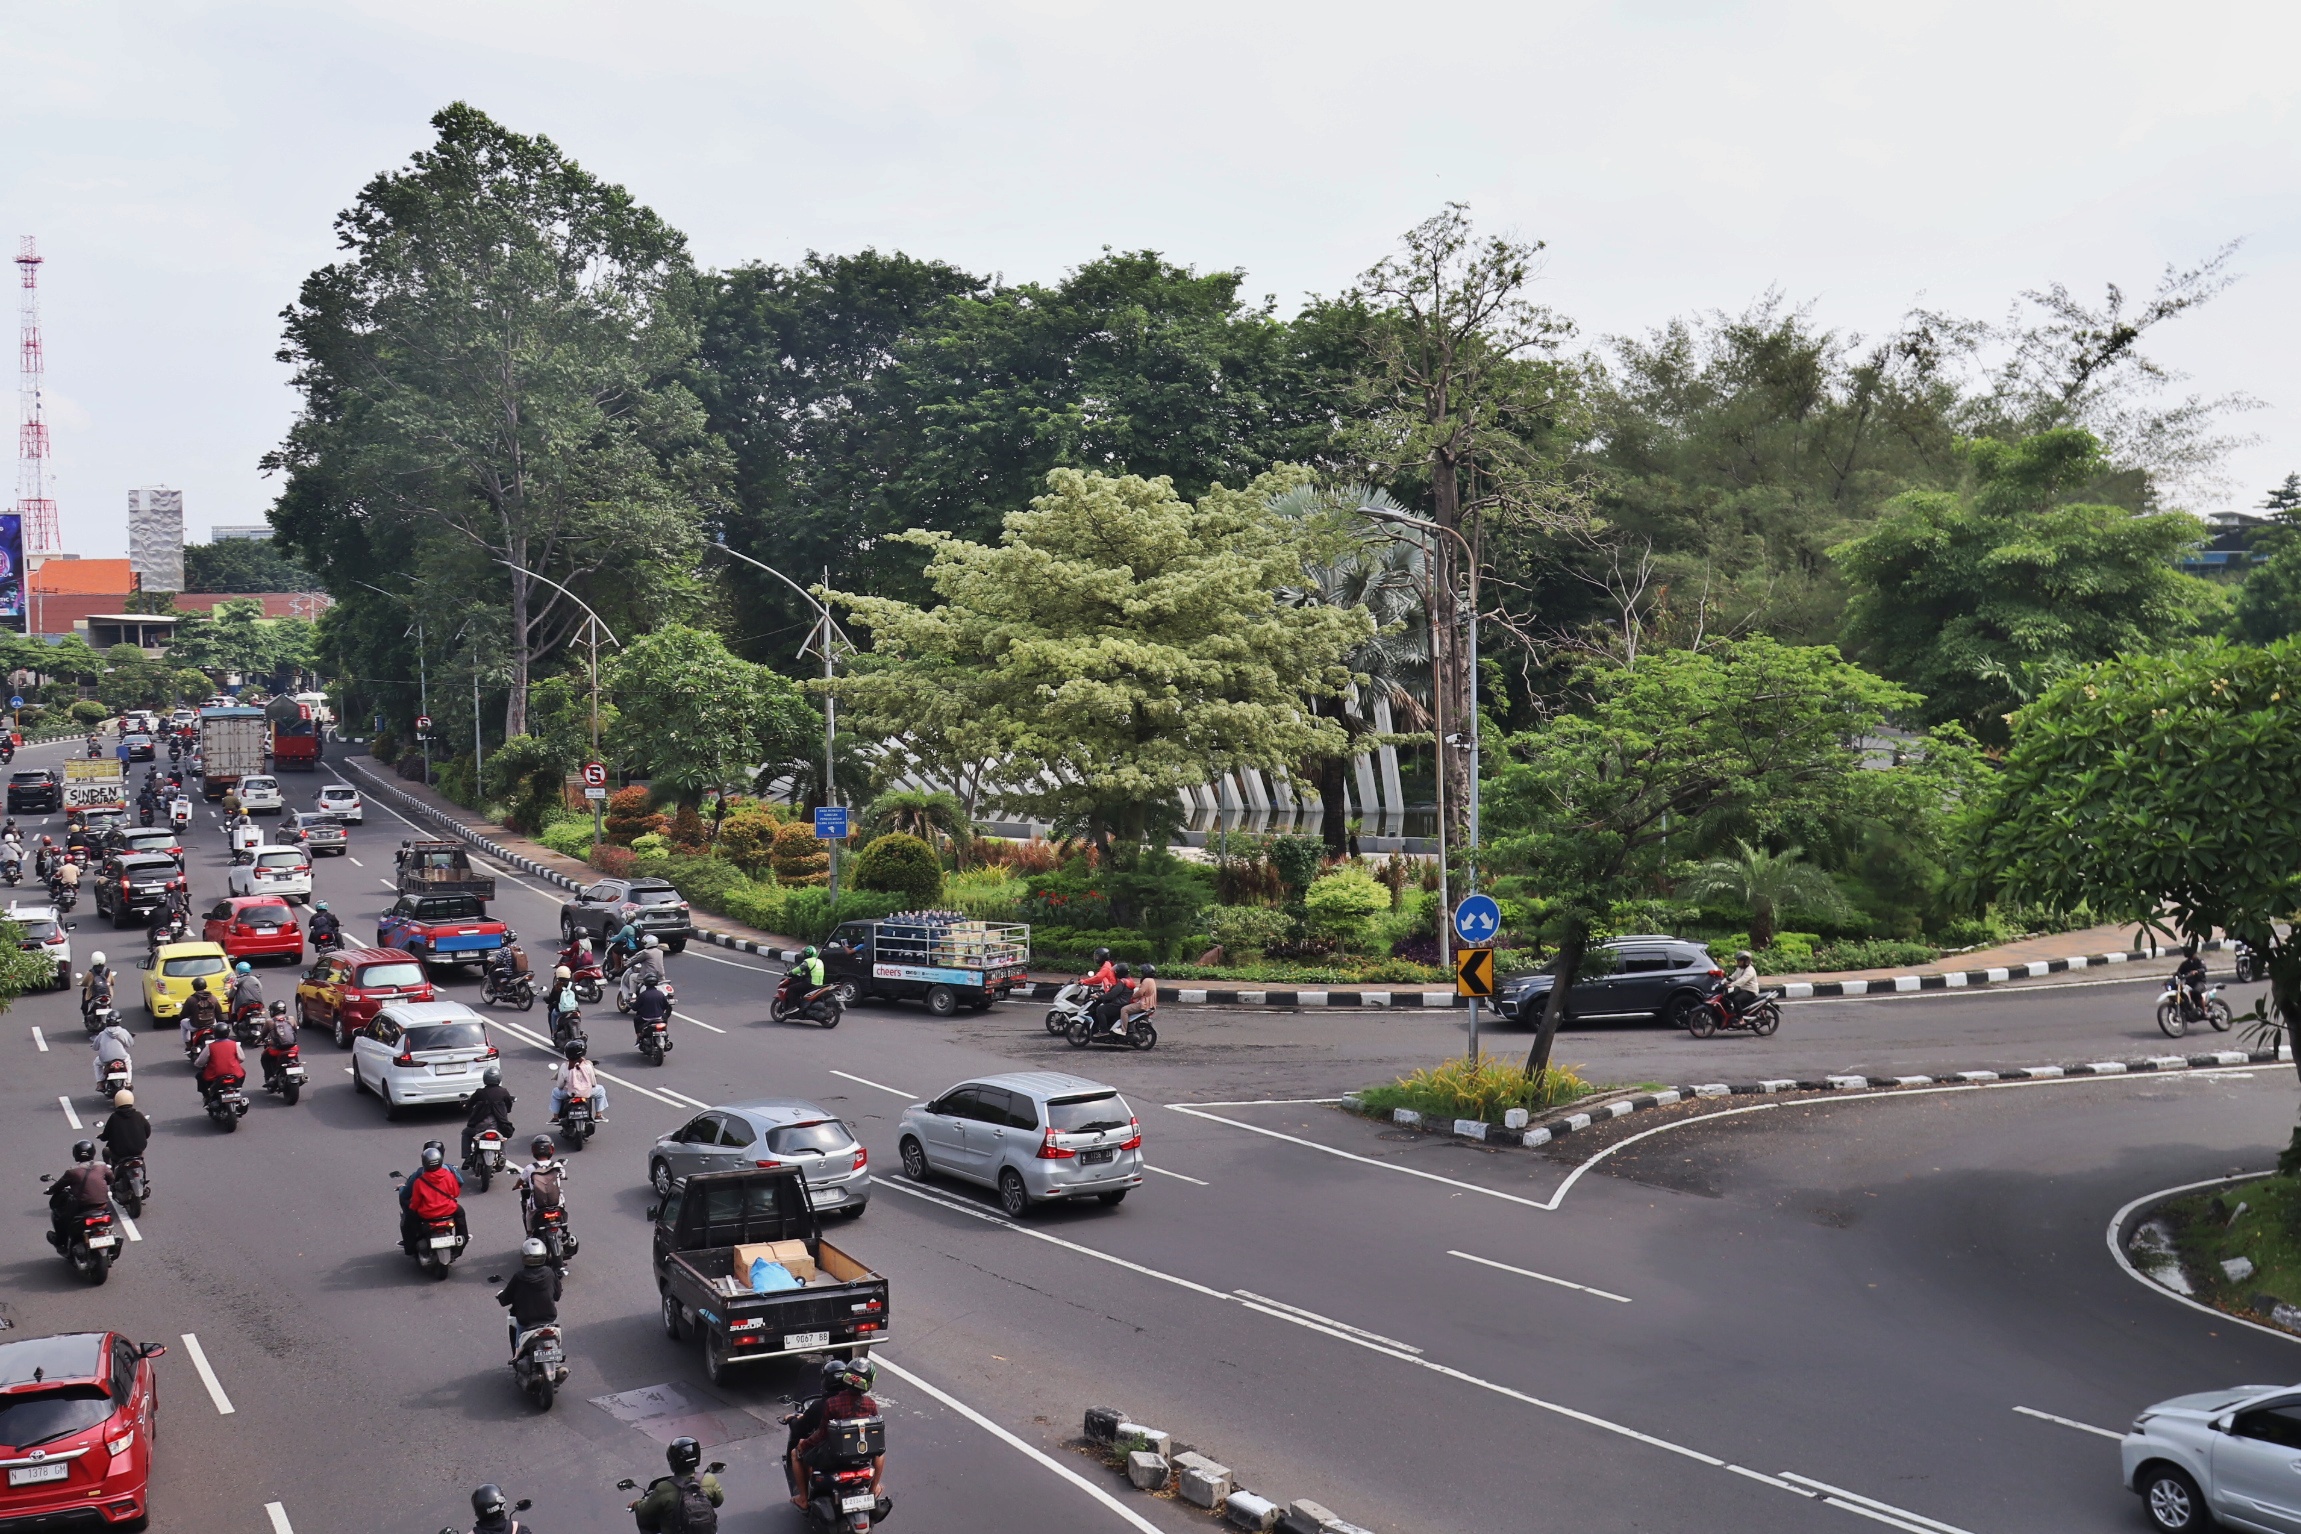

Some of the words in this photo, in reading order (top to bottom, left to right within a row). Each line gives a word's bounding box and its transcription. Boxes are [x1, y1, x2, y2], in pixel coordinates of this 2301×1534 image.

[70, 787, 117, 801] SINDEN
[876, 966, 902, 977] cheers
[785, 1336, 791, 1345] L
[796, 1334, 814, 1344] 9067
[818, 1332, 828, 1342] BB
[11, 1471, 17, 1480] N
[28, 1467, 49, 1478] 1378
[54, 1465, 67, 1475] GM
